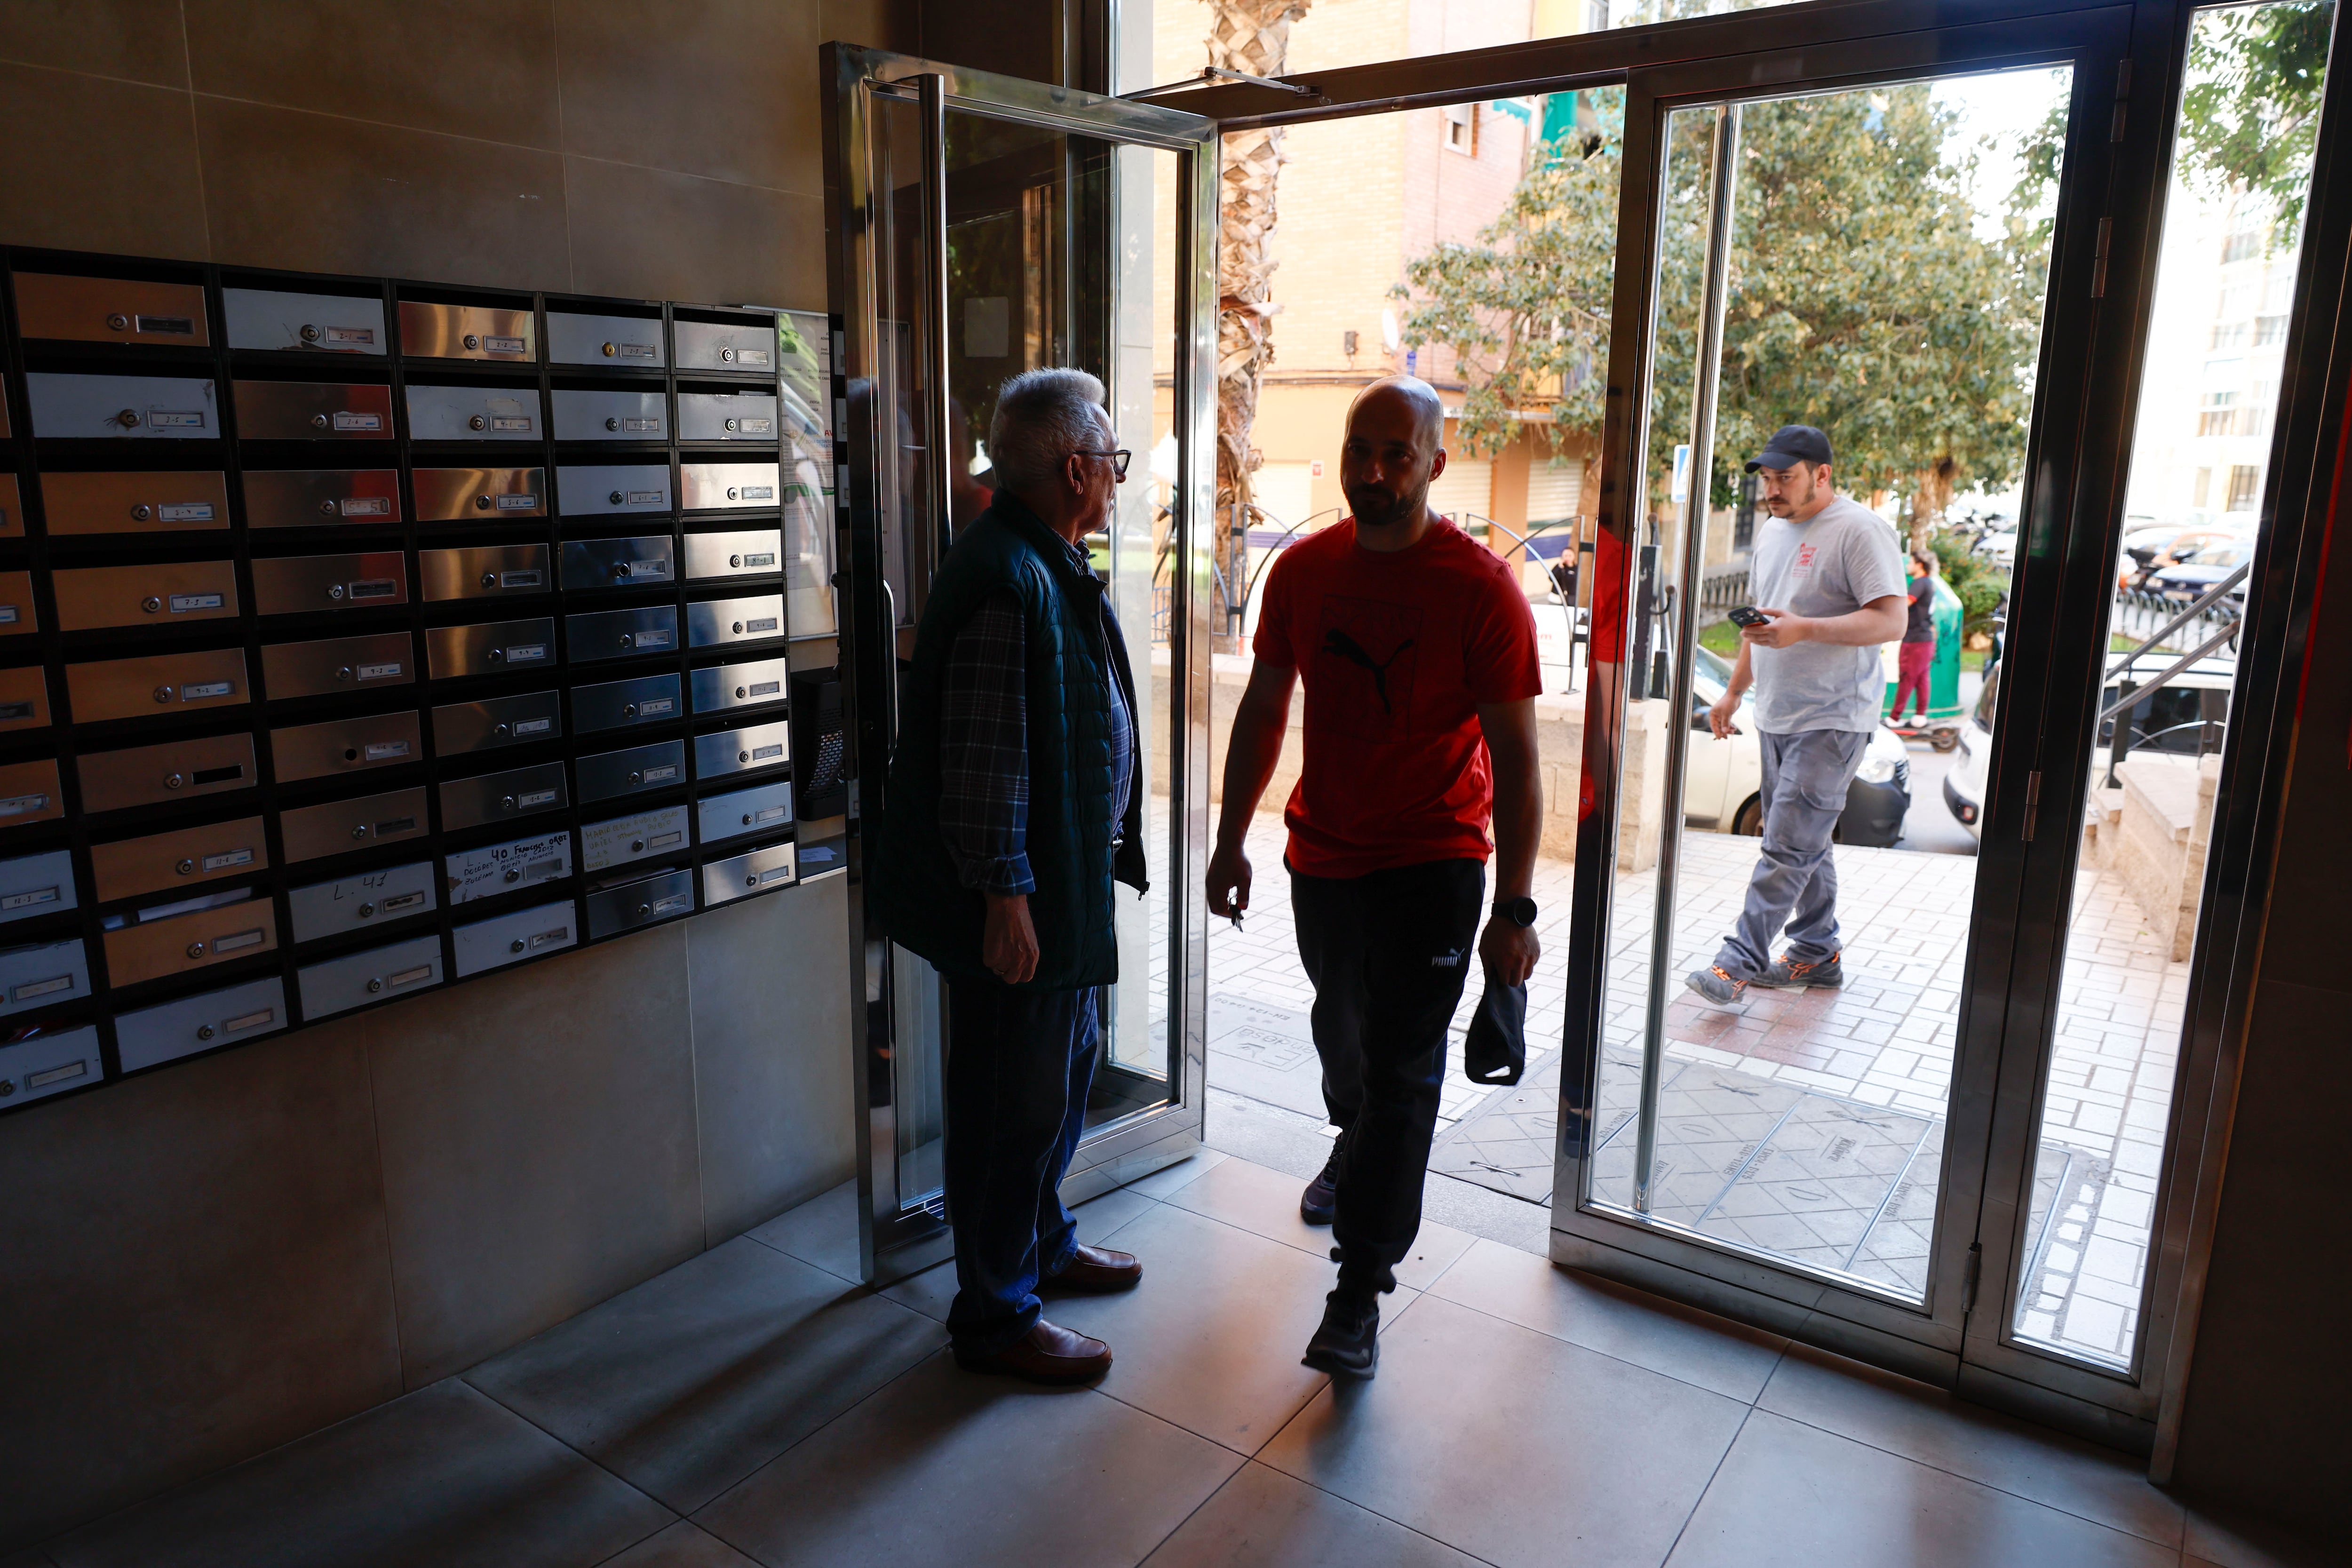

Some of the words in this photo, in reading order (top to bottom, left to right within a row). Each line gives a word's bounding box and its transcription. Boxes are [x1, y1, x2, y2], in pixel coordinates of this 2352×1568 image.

[492, 849, 508, 861] 40
[1431, 955, 1458, 967] PUMA
[1249, 1007, 1290, 1020] EN-124
[1239, 1028, 1317, 1054] endesa
